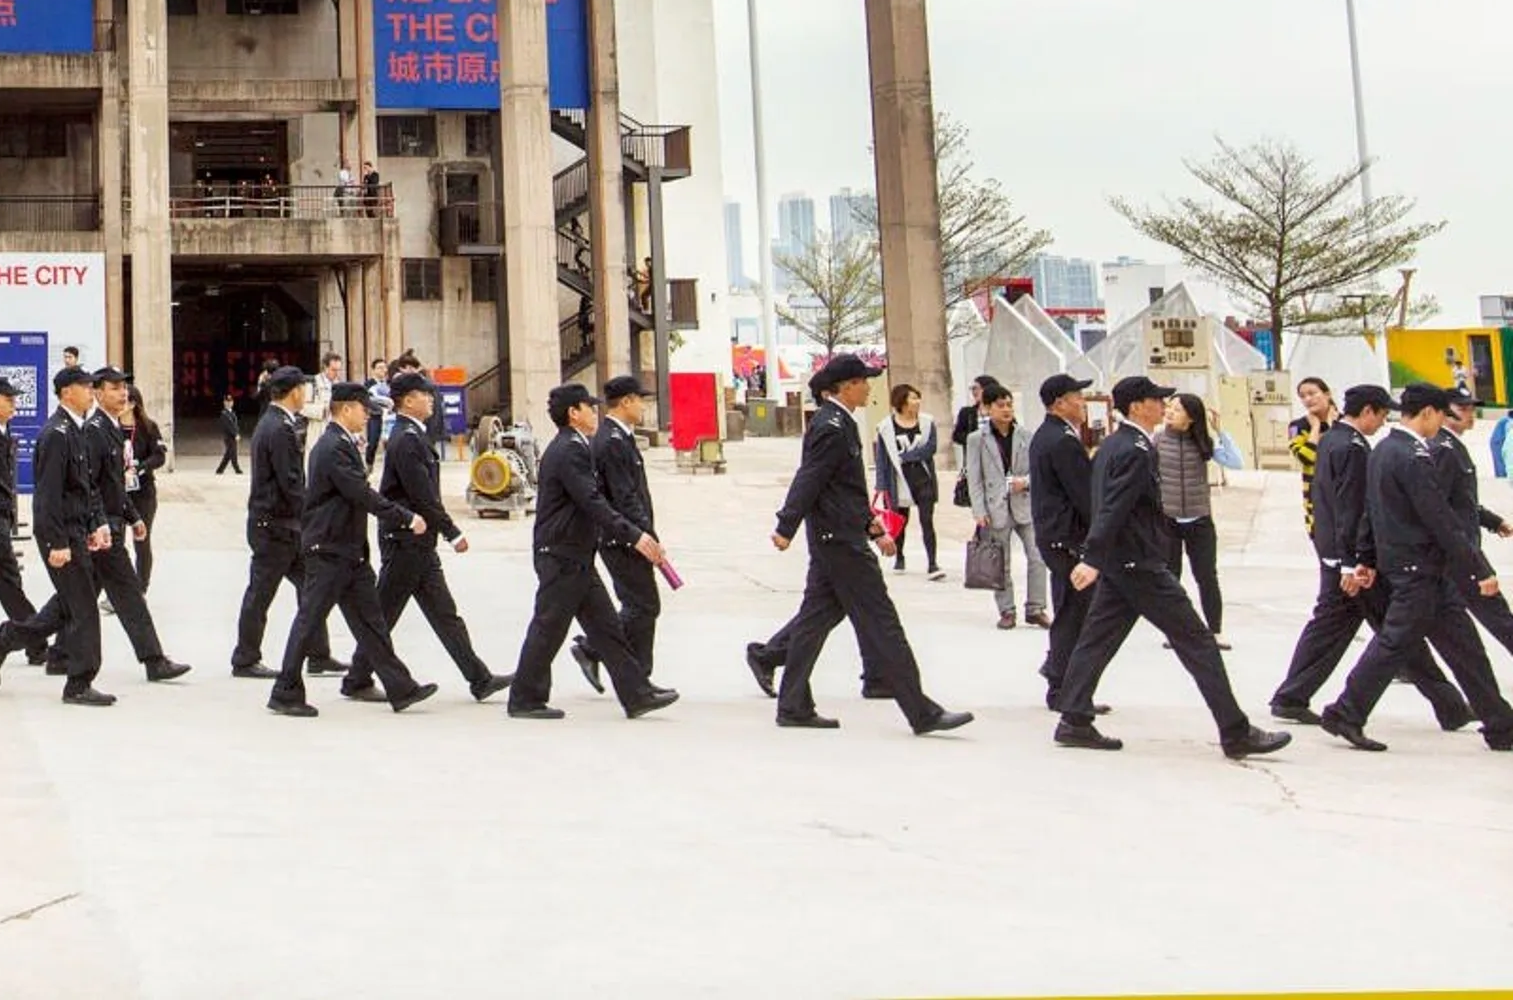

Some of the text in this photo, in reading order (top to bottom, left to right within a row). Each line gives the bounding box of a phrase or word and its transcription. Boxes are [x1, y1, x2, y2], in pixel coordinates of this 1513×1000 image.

[387, 13, 501, 42] THE CI
[34, 265, 88, 285] CITY
